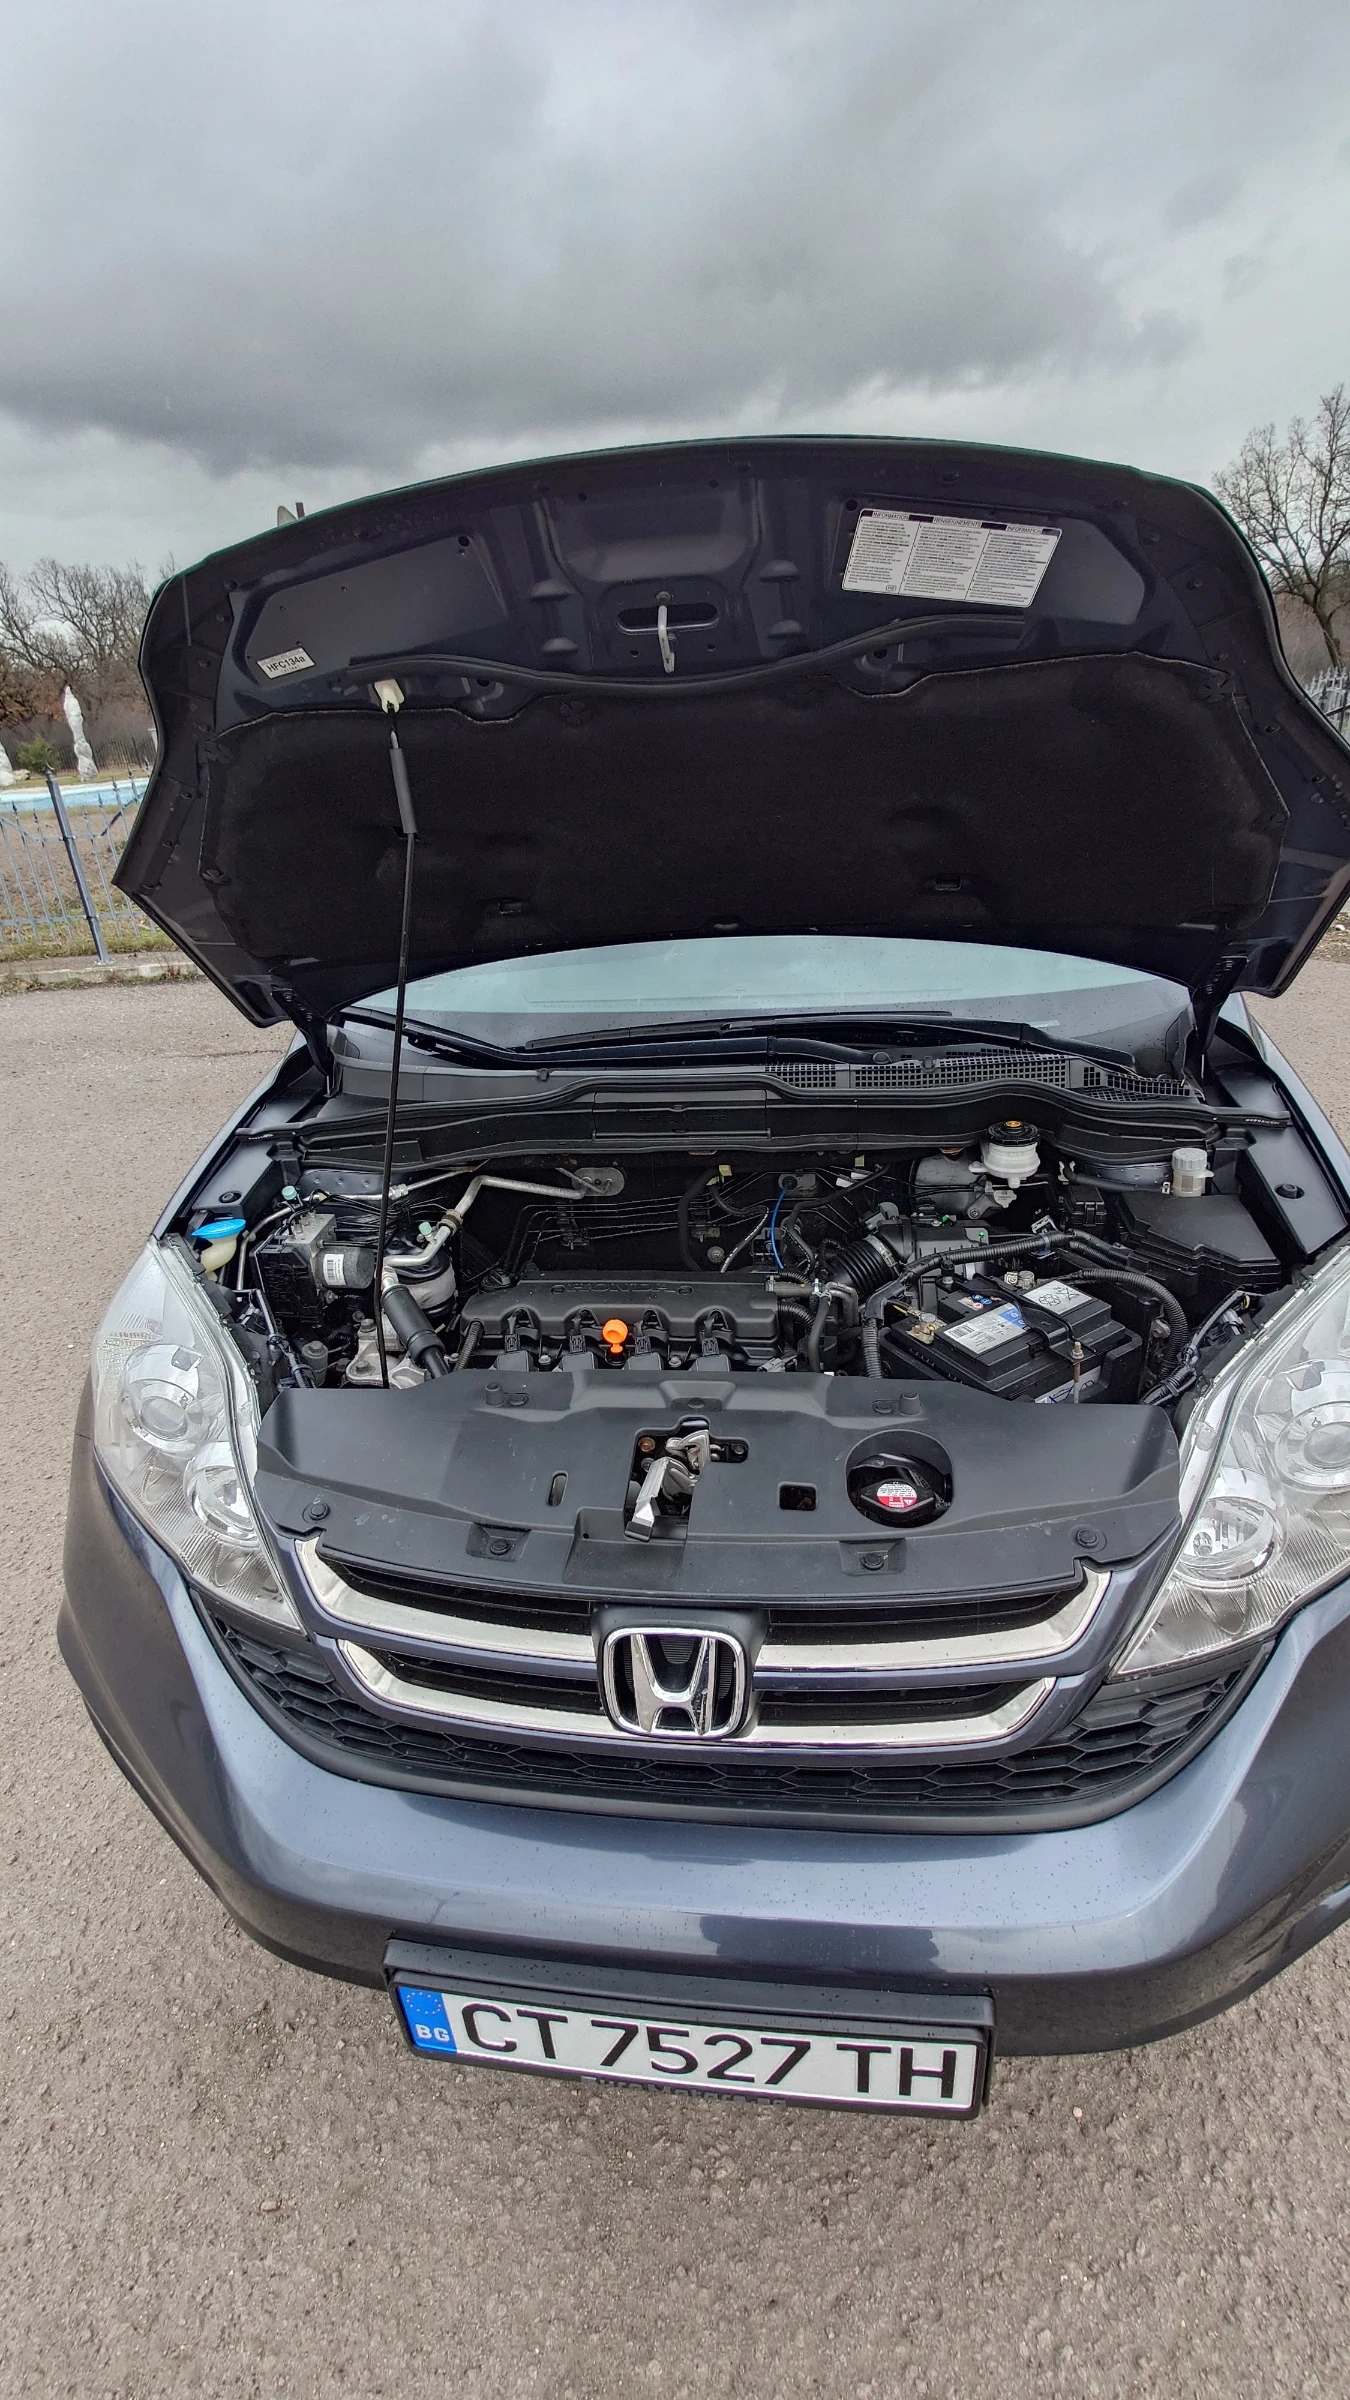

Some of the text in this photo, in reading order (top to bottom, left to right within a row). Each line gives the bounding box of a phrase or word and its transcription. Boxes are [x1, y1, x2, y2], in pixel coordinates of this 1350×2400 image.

[266, 656, 306, 673] HFC134a
[415, 2024, 450, 2042] BG
[461, 2003, 957, 2099] CT 7527 TH
